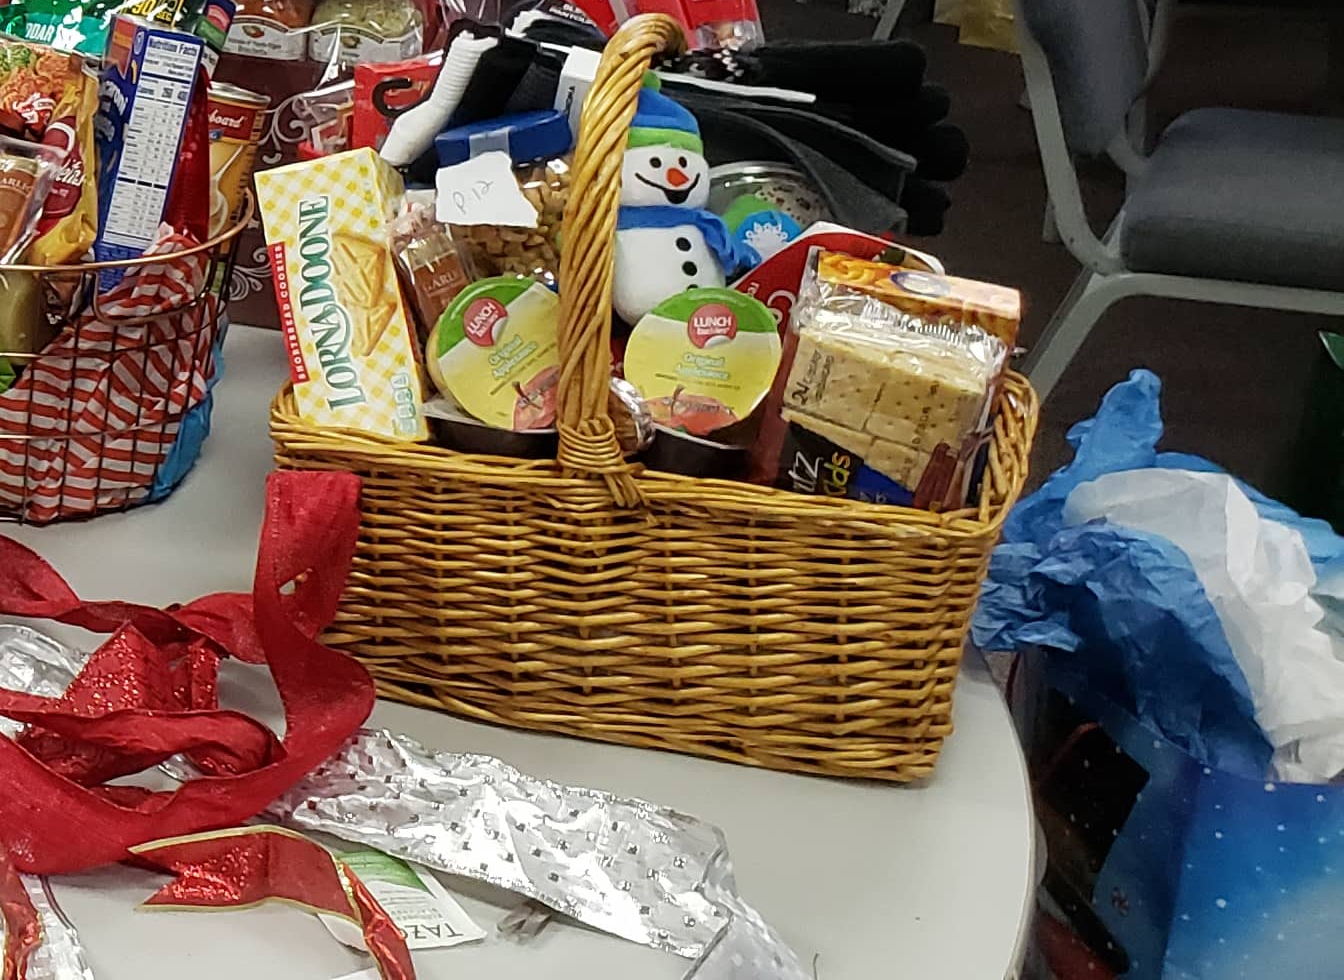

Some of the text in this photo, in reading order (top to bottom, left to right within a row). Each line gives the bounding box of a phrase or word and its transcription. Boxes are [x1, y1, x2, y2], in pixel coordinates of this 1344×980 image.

[298, 195, 336, 311] DOONE
[466, 302, 498, 335] LUNCH
[693, 315, 732, 328] LUNCH
[310, 303, 368, 411] LORNA
